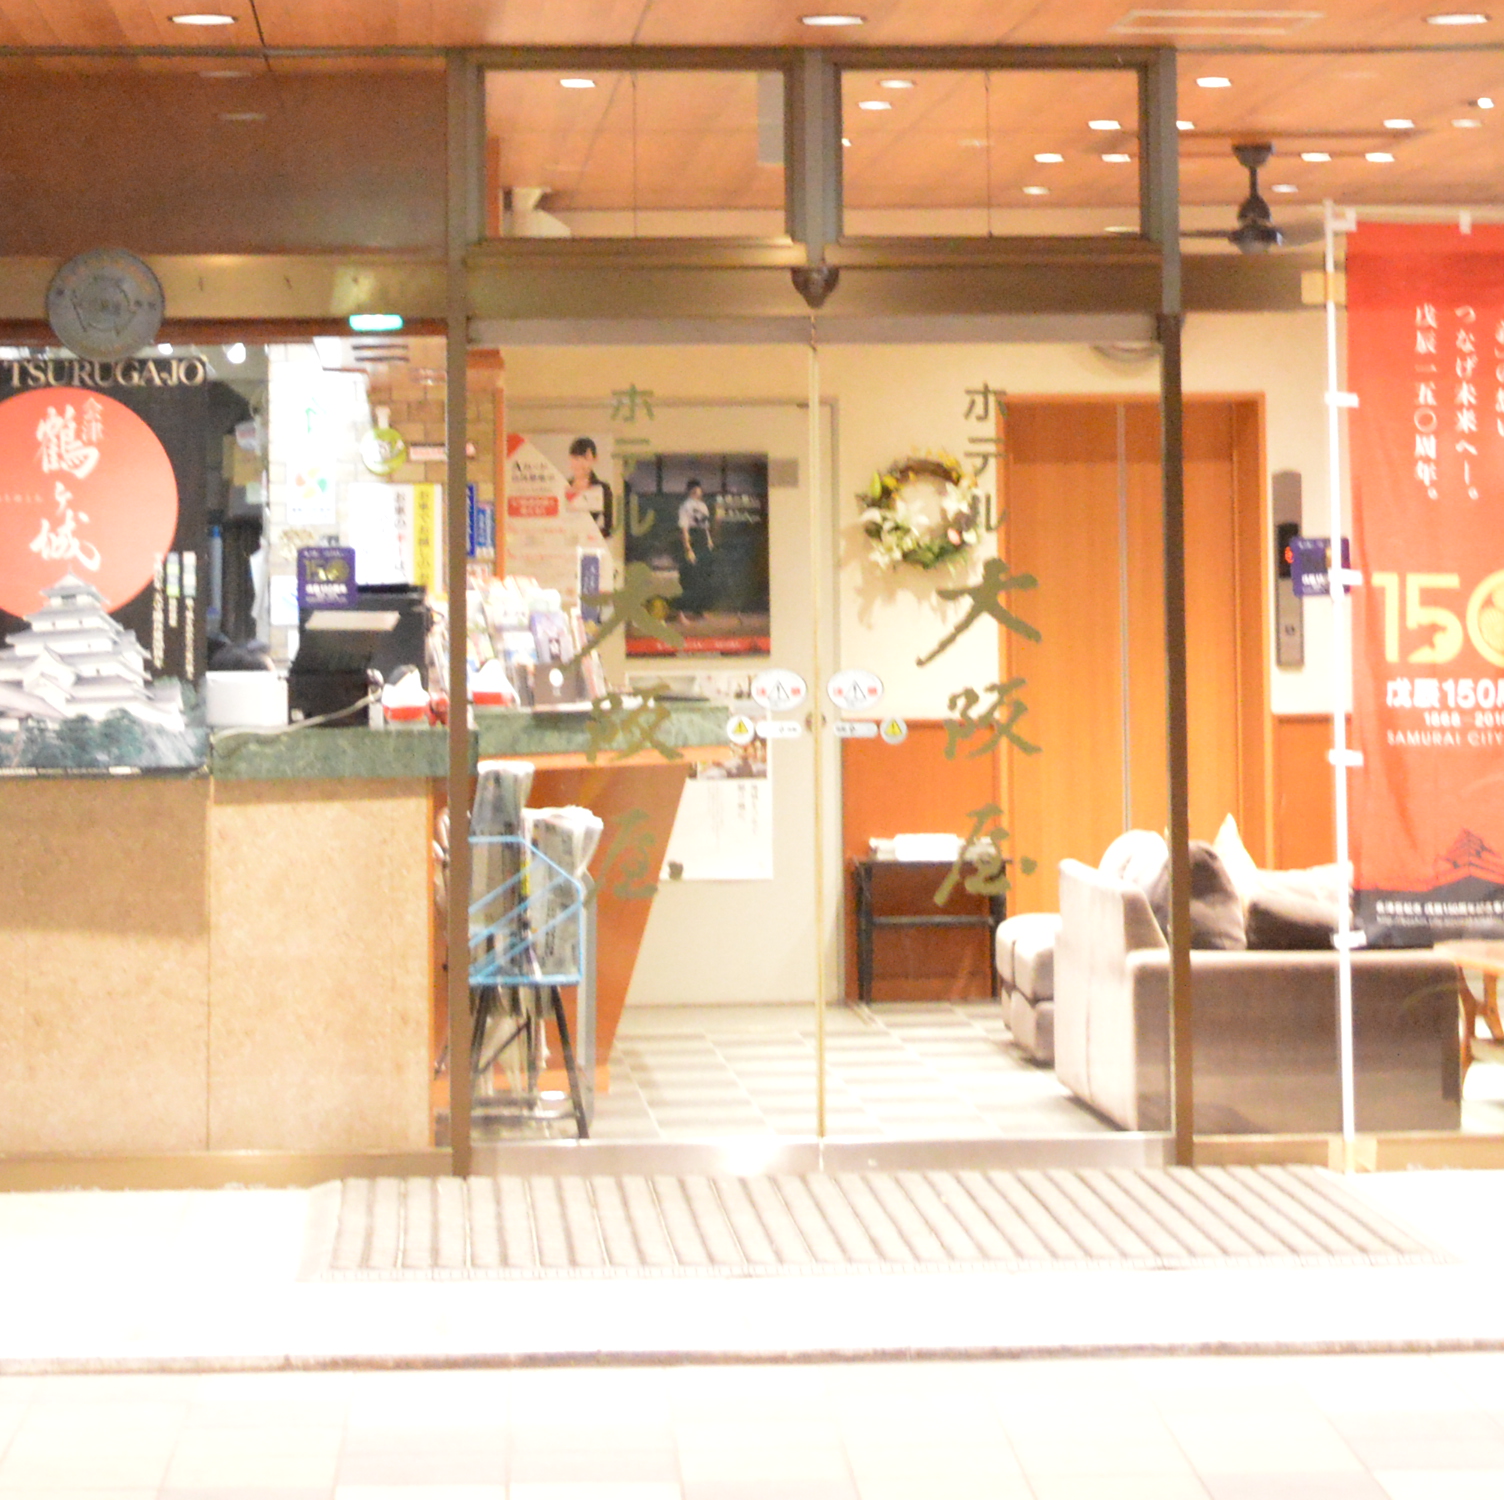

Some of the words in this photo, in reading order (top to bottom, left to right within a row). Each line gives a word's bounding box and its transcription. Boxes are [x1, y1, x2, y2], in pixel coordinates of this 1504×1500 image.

[963, 382, 1008, 533] ホテル
[915, 557, 1043, 907] 大阪屋
[1387, 729, 1460, 747] SAMURAI
[1467, 729, 1503, 747] CITY
